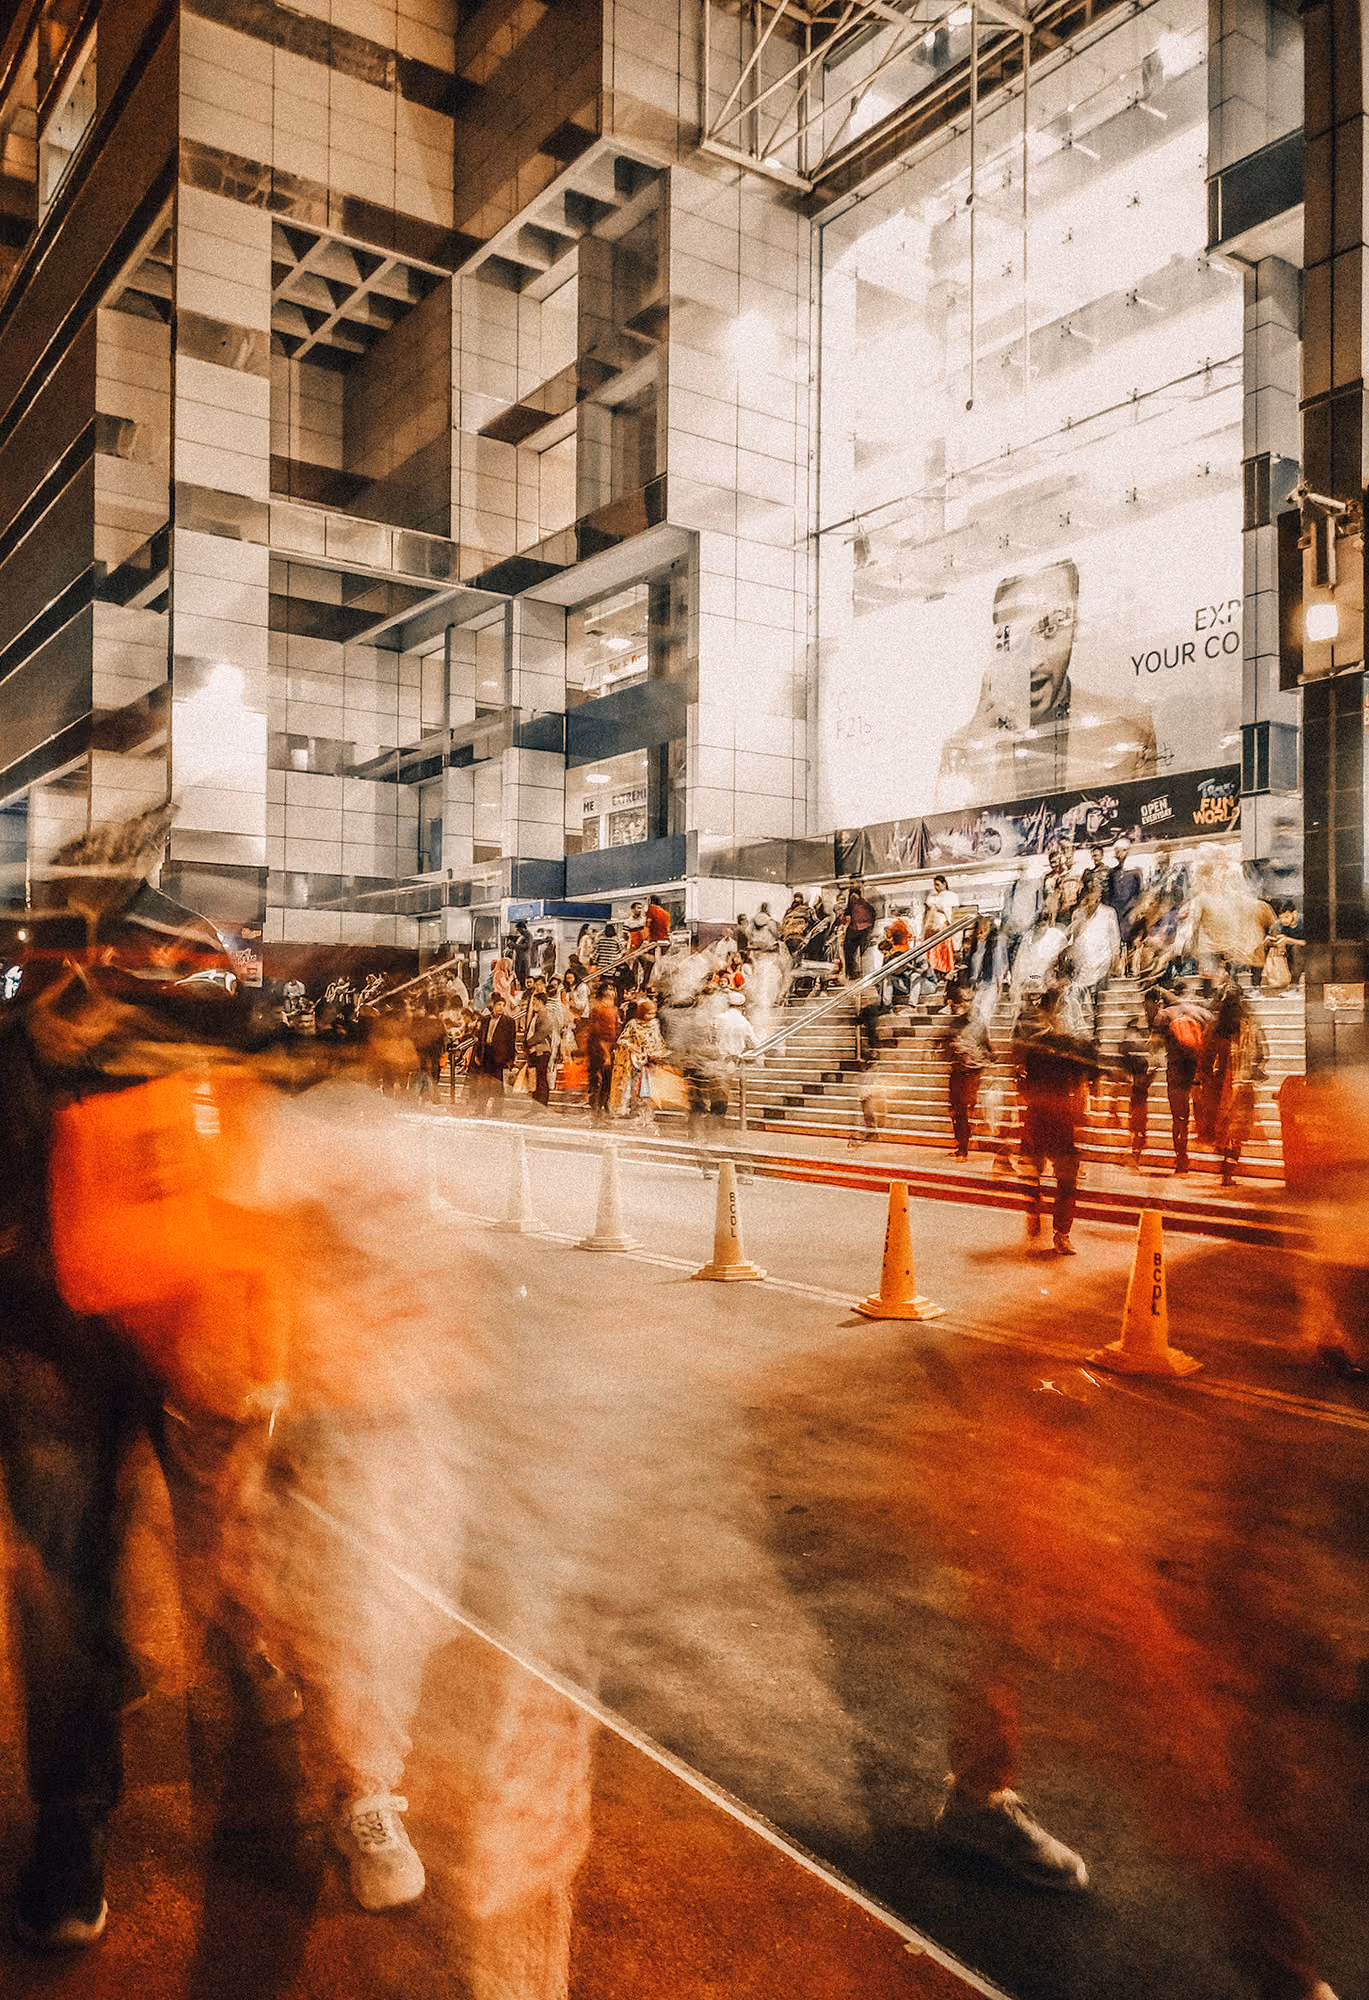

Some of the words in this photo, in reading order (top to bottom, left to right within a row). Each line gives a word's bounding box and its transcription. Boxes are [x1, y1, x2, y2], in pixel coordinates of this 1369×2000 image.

[1131, 642, 1196, 676] YOUR
[1204, 631, 1240, 659] CO
[1140, 798, 1168, 817] OPEN
[1200, 795, 1235, 812] FUN
[729, 1191, 737, 1238] BCDL
[1151, 1252, 1162, 1316] BCDL
